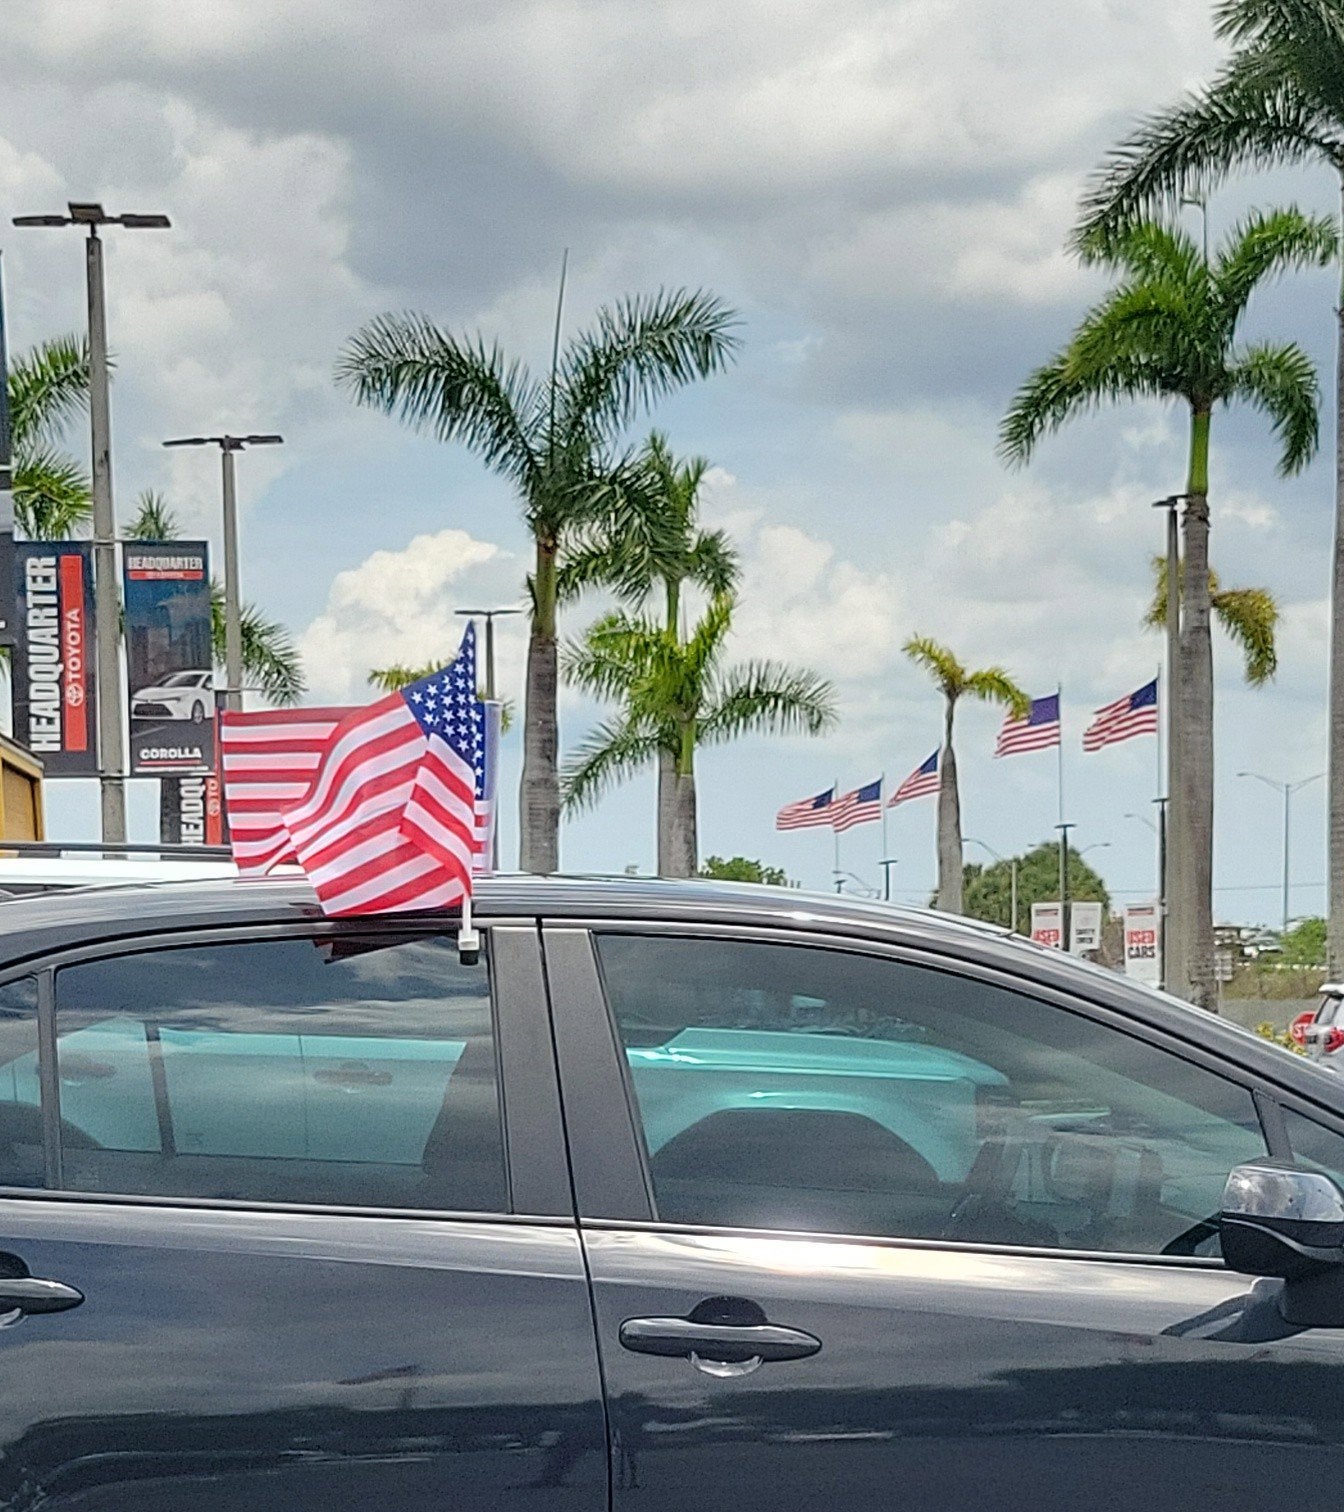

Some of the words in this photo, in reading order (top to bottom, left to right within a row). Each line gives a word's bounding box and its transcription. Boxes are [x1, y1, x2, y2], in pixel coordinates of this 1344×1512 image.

[26, 556, 63, 752] HEADQUARTER
[65, 608, 82, 682] TOYOTA
[140, 747, 202, 760] COROLLA
